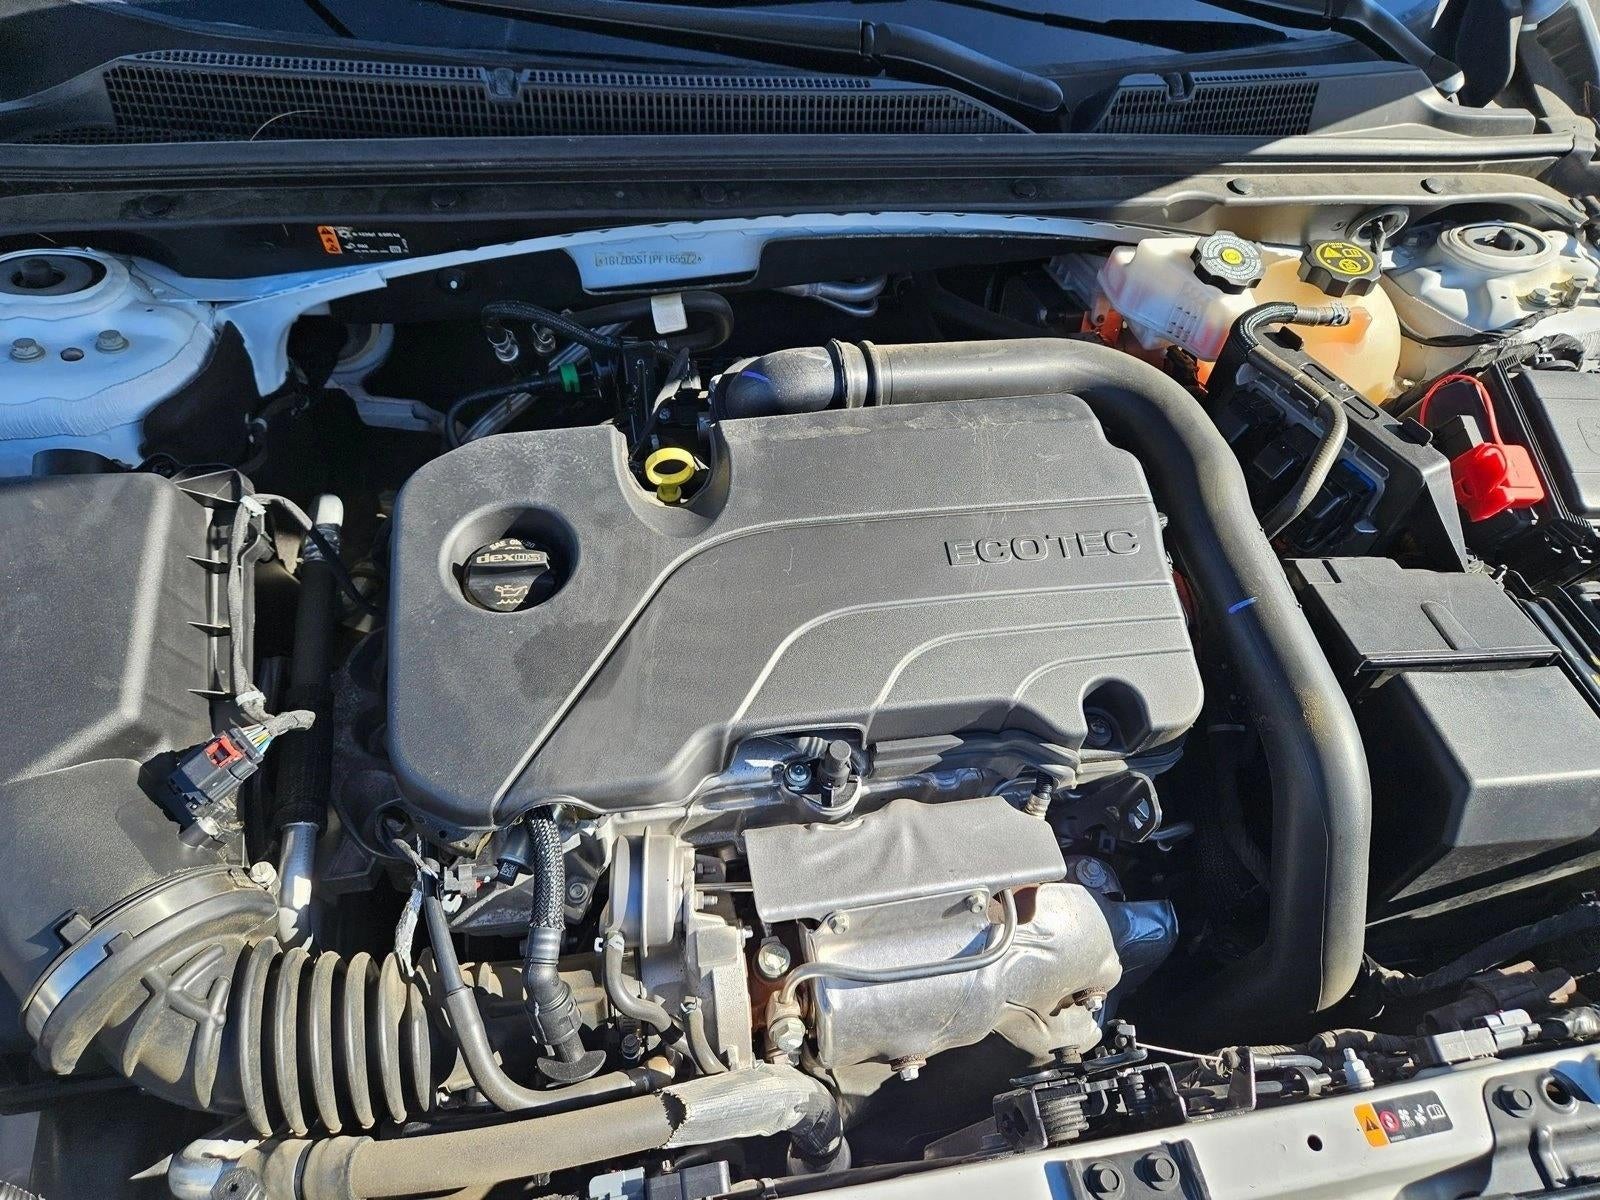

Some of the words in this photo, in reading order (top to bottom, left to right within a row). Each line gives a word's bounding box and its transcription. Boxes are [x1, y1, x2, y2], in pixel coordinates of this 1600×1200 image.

[489, 540, 508, 550] SAE
[944, 529, 1141, 567] ECOTEC
[476, 552, 541, 564] dexos
